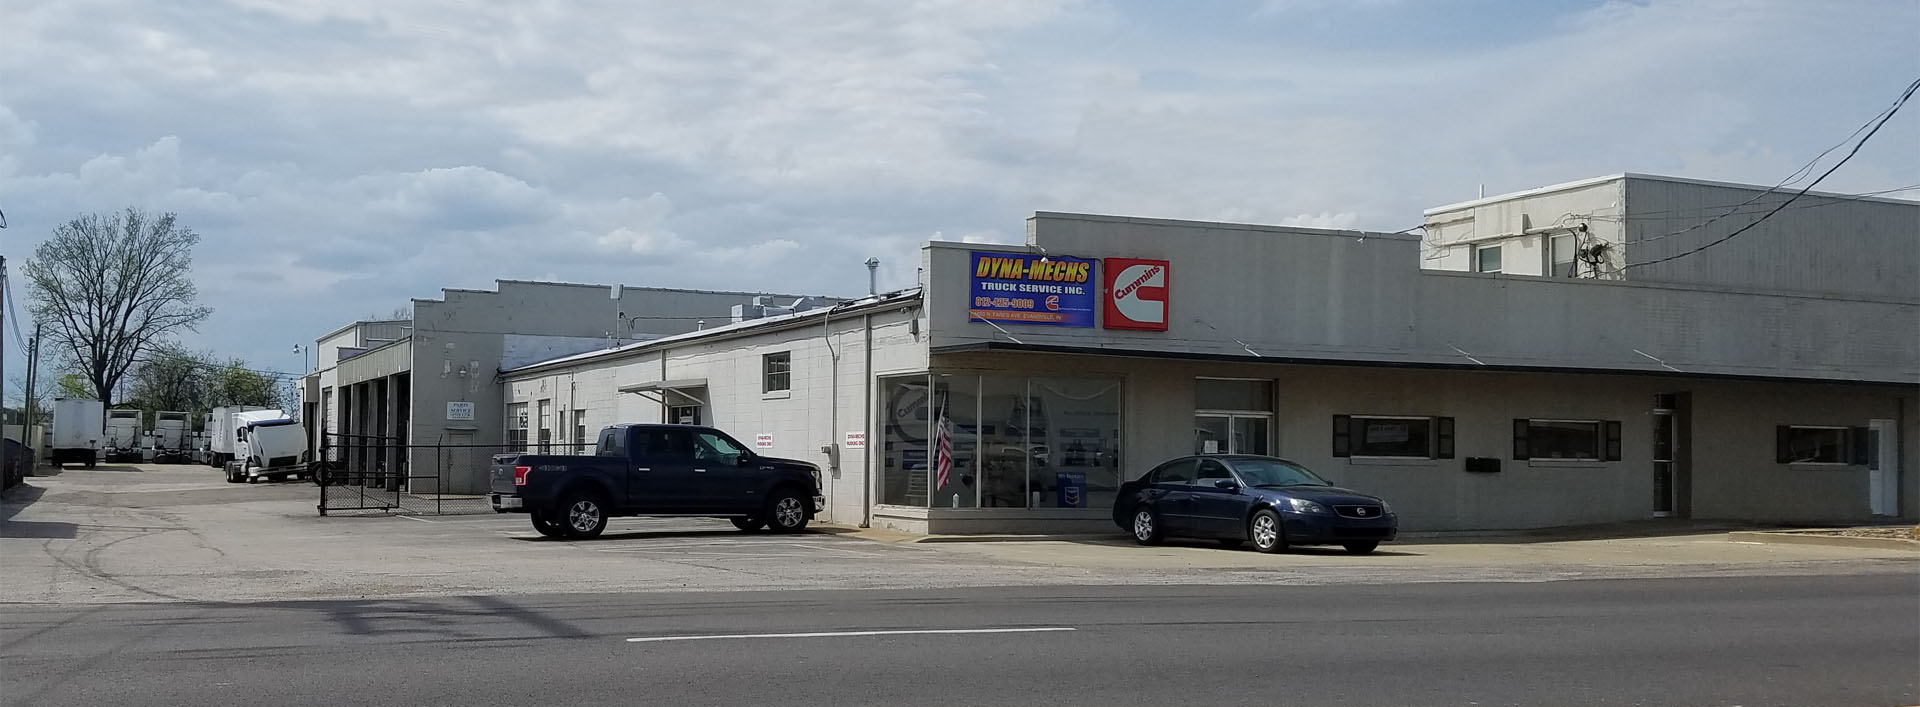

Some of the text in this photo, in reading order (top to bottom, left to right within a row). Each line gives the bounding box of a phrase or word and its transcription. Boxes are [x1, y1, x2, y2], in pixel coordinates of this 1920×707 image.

[976, 256, 1090, 283] DYNA-MECHS
[1114, 265, 1161, 301] Cummins
[981, 282, 1086, 295] TRUCK SERVICE INC.
